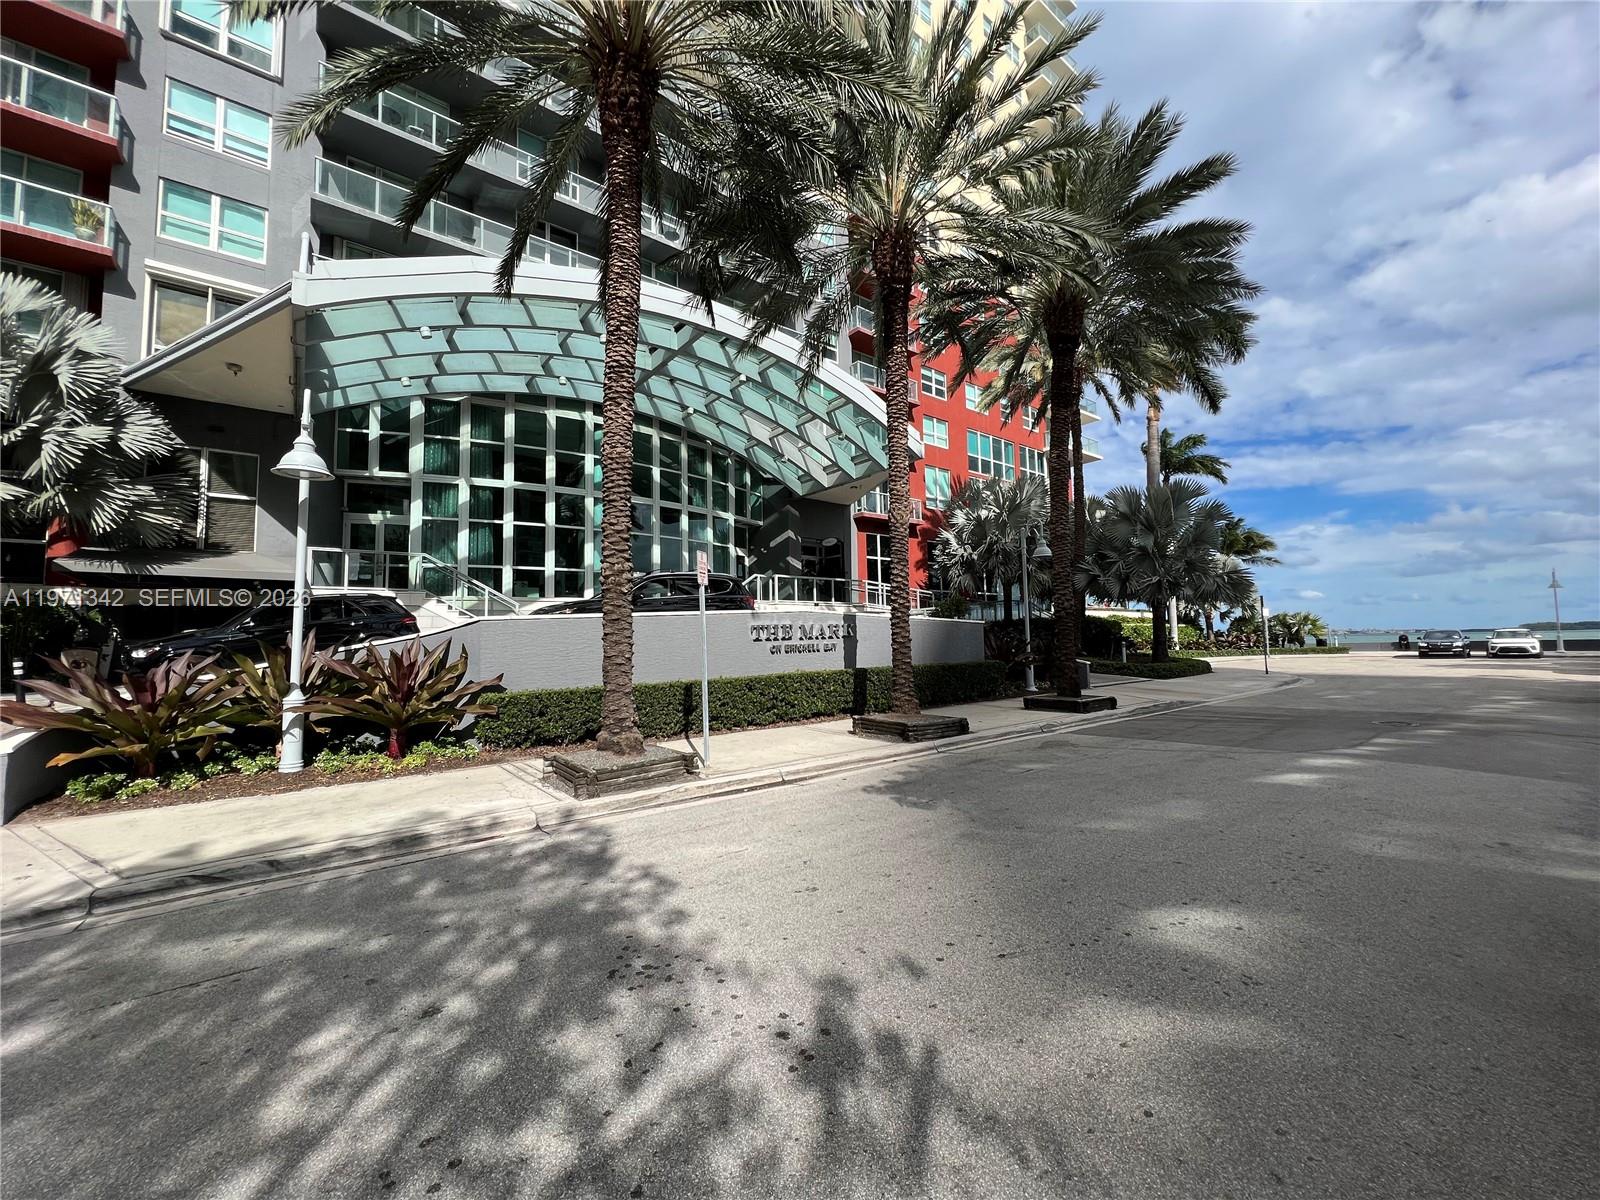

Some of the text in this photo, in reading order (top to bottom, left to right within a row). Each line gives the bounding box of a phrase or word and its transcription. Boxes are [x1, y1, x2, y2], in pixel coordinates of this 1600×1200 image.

[750, 623, 855, 642] THE MARK
[769, 644, 782, 655] ON
